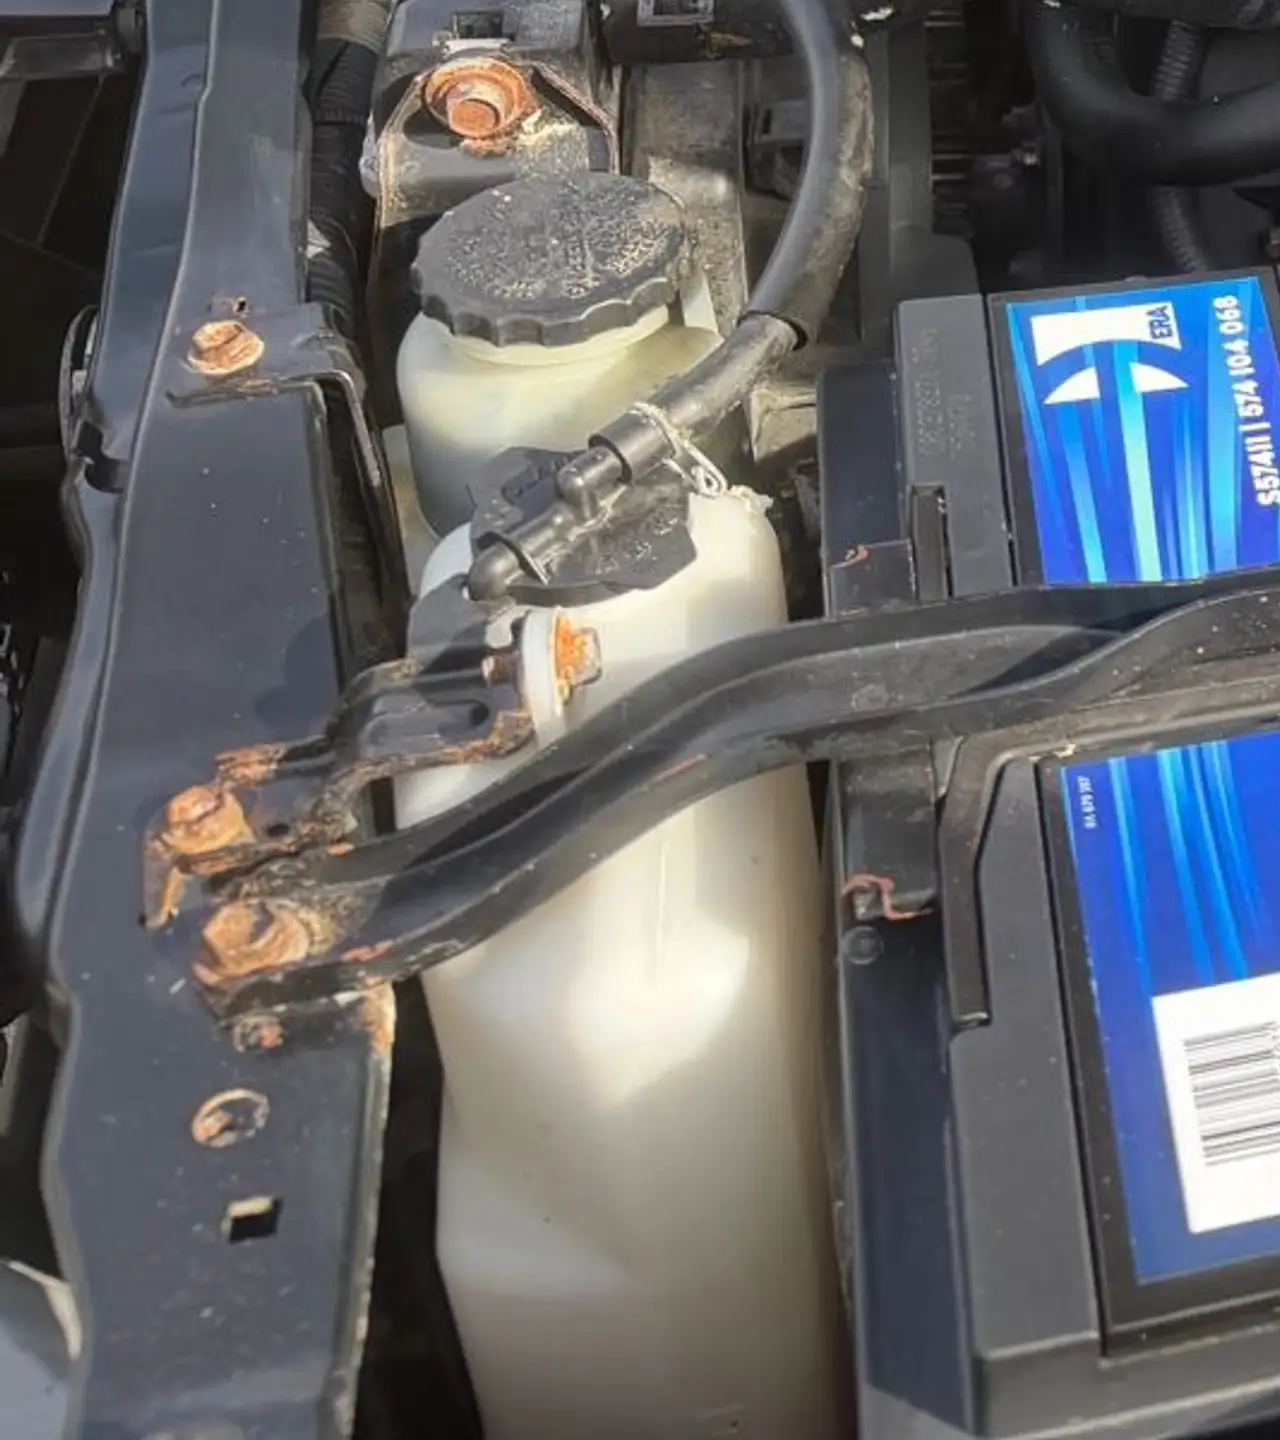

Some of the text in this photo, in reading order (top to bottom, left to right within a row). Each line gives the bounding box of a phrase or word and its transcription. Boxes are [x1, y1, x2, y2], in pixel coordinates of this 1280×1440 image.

[1212, 294, 1244, 335] 068
[1221, 338, 1256, 376] 104
[1231, 379, 1264, 418] 574
